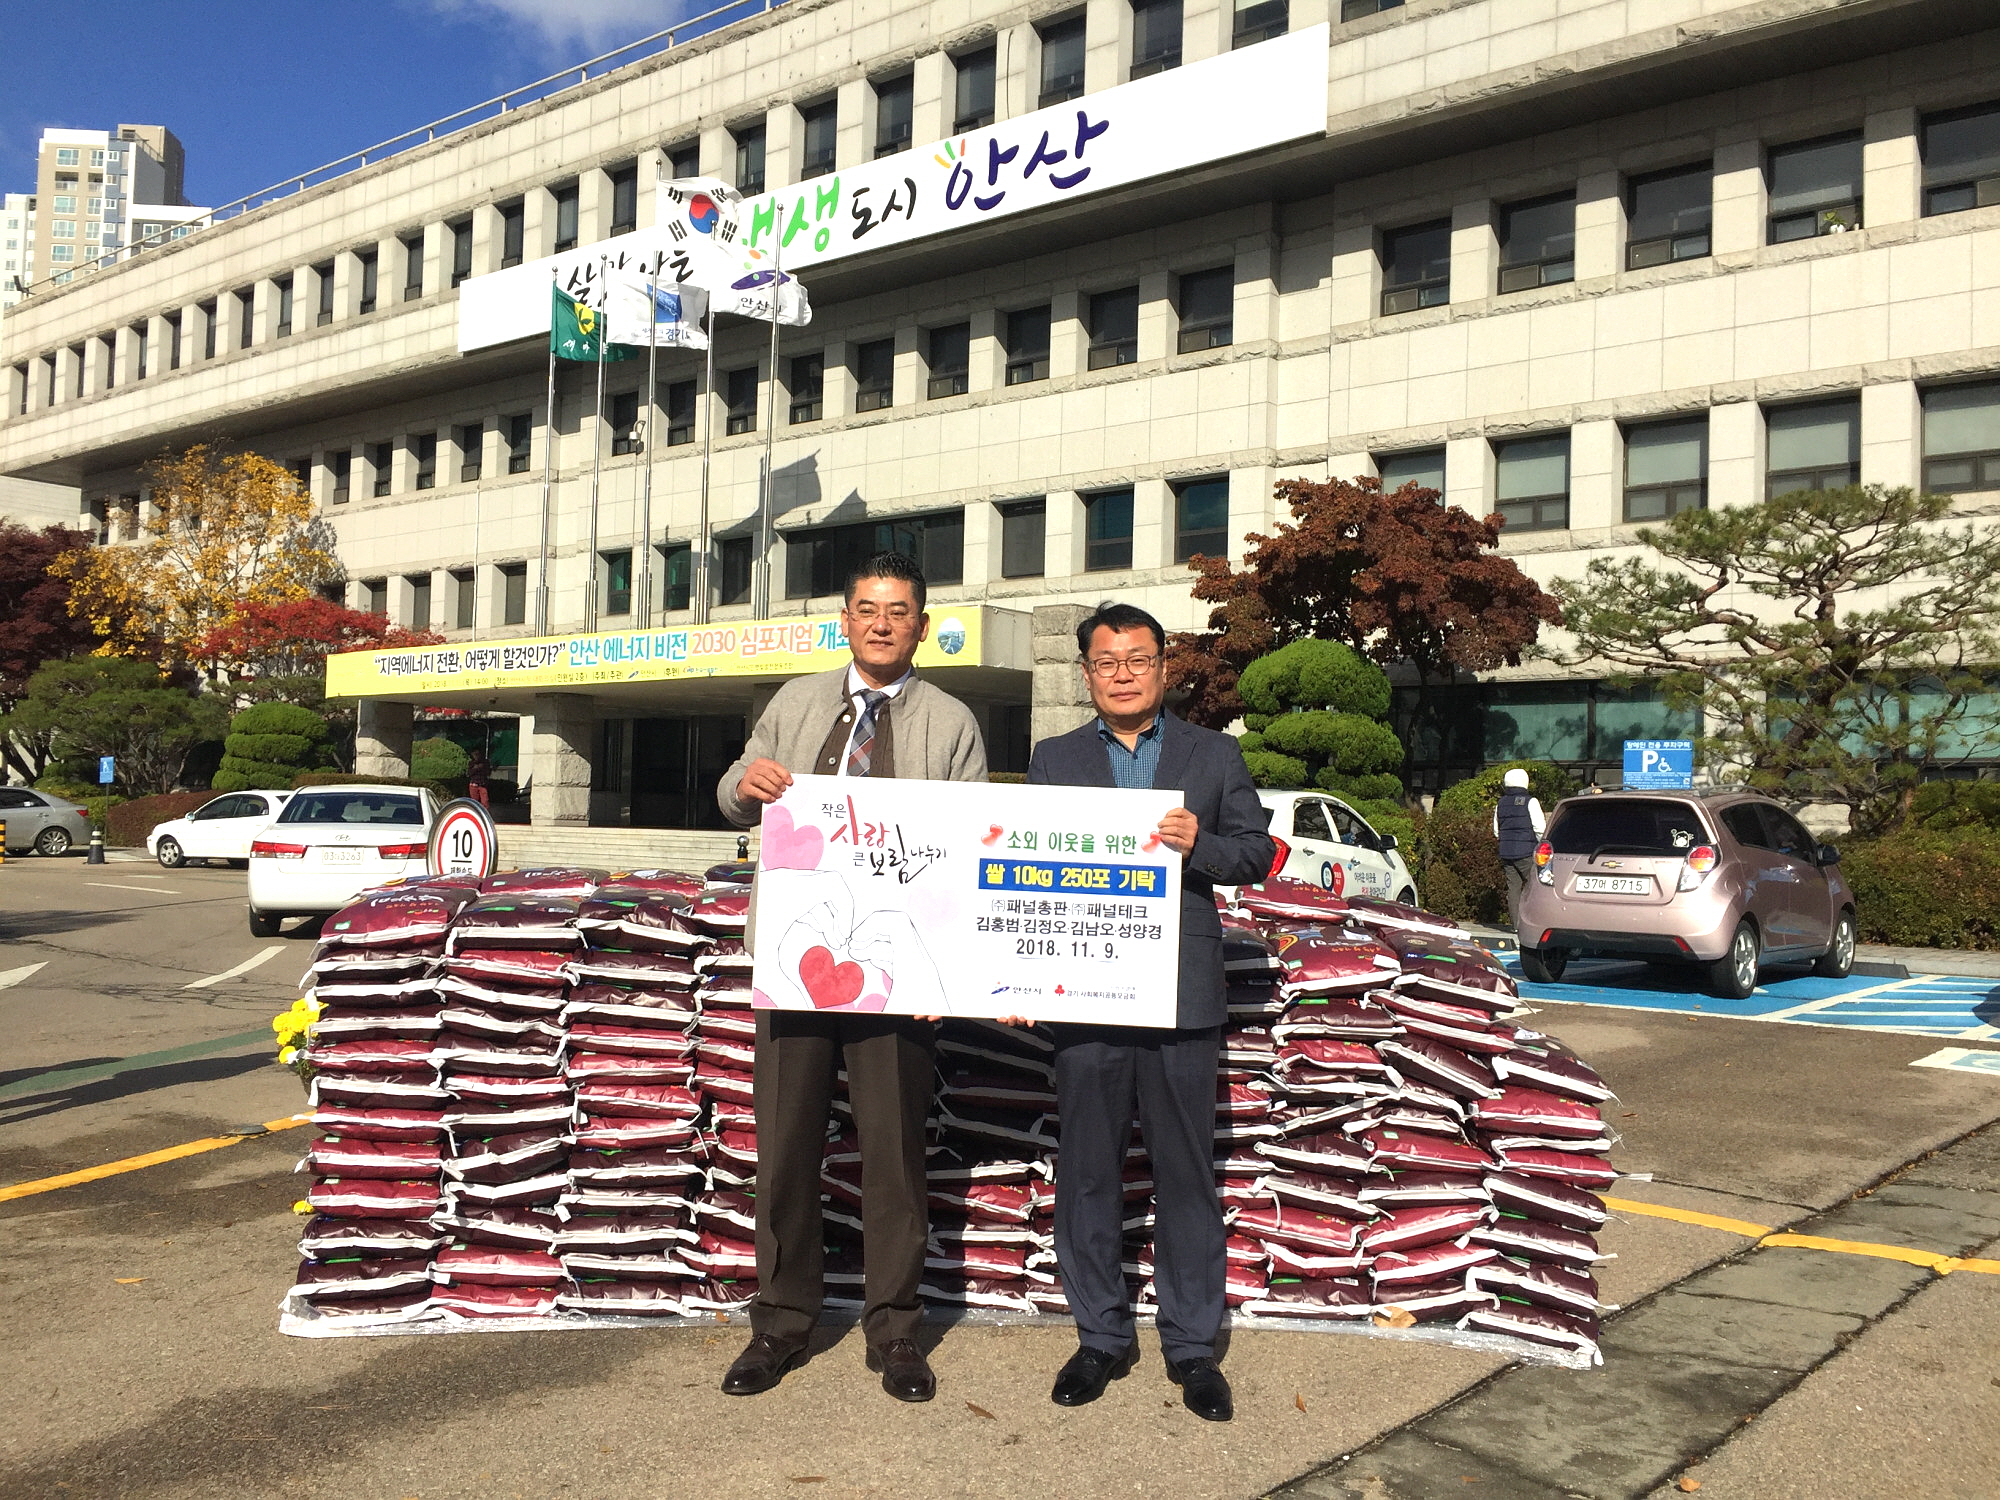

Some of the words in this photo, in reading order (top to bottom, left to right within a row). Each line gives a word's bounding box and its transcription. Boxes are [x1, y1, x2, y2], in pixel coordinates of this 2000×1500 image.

[852, 177, 917, 240] 도시
[945, 111, 1110, 211] 안산
[436, 651, 462, 673] 전환,
[465, 648, 500, 671] 어떻게
[569, 638, 600, 666] 안산
[603, 635, 650, 662] 에너지
[654, 632, 688, 660] 비전
[692, 629, 736, 654] 2030
[740, 623, 813, 656] 심포지엄
[1642, 750, 1659, 773] P
[821, 803, 847, 818] 작은
[830, 794, 890, 848] 사랑
[453, 829, 473, 858] 10
[1007, 830, 1038, 850] 소외
[1048, 832, 1095, 853] 이웃을
[1105, 834, 1137, 855] 위한
[852, 851, 866, 866] 큰
[910, 845, 947, 864] 나누기
[986, 863, 1006, 885] 쌀
[1012, 865, 1054, 887] 10kg
[1060, 867, 1111, 889] 250포
[1118, 870, 1156, 892] 기탁
[1583, 878, 1606, 890] 37어
[1611, 880, 1643, 892] 8715
[1016, 938, 1061, 957] 2018.
[1071, 941, 1095, 958] 11.
[1104, 942, 1119, 959] 9.
[1012, 986, 1042, 995] 안산시
